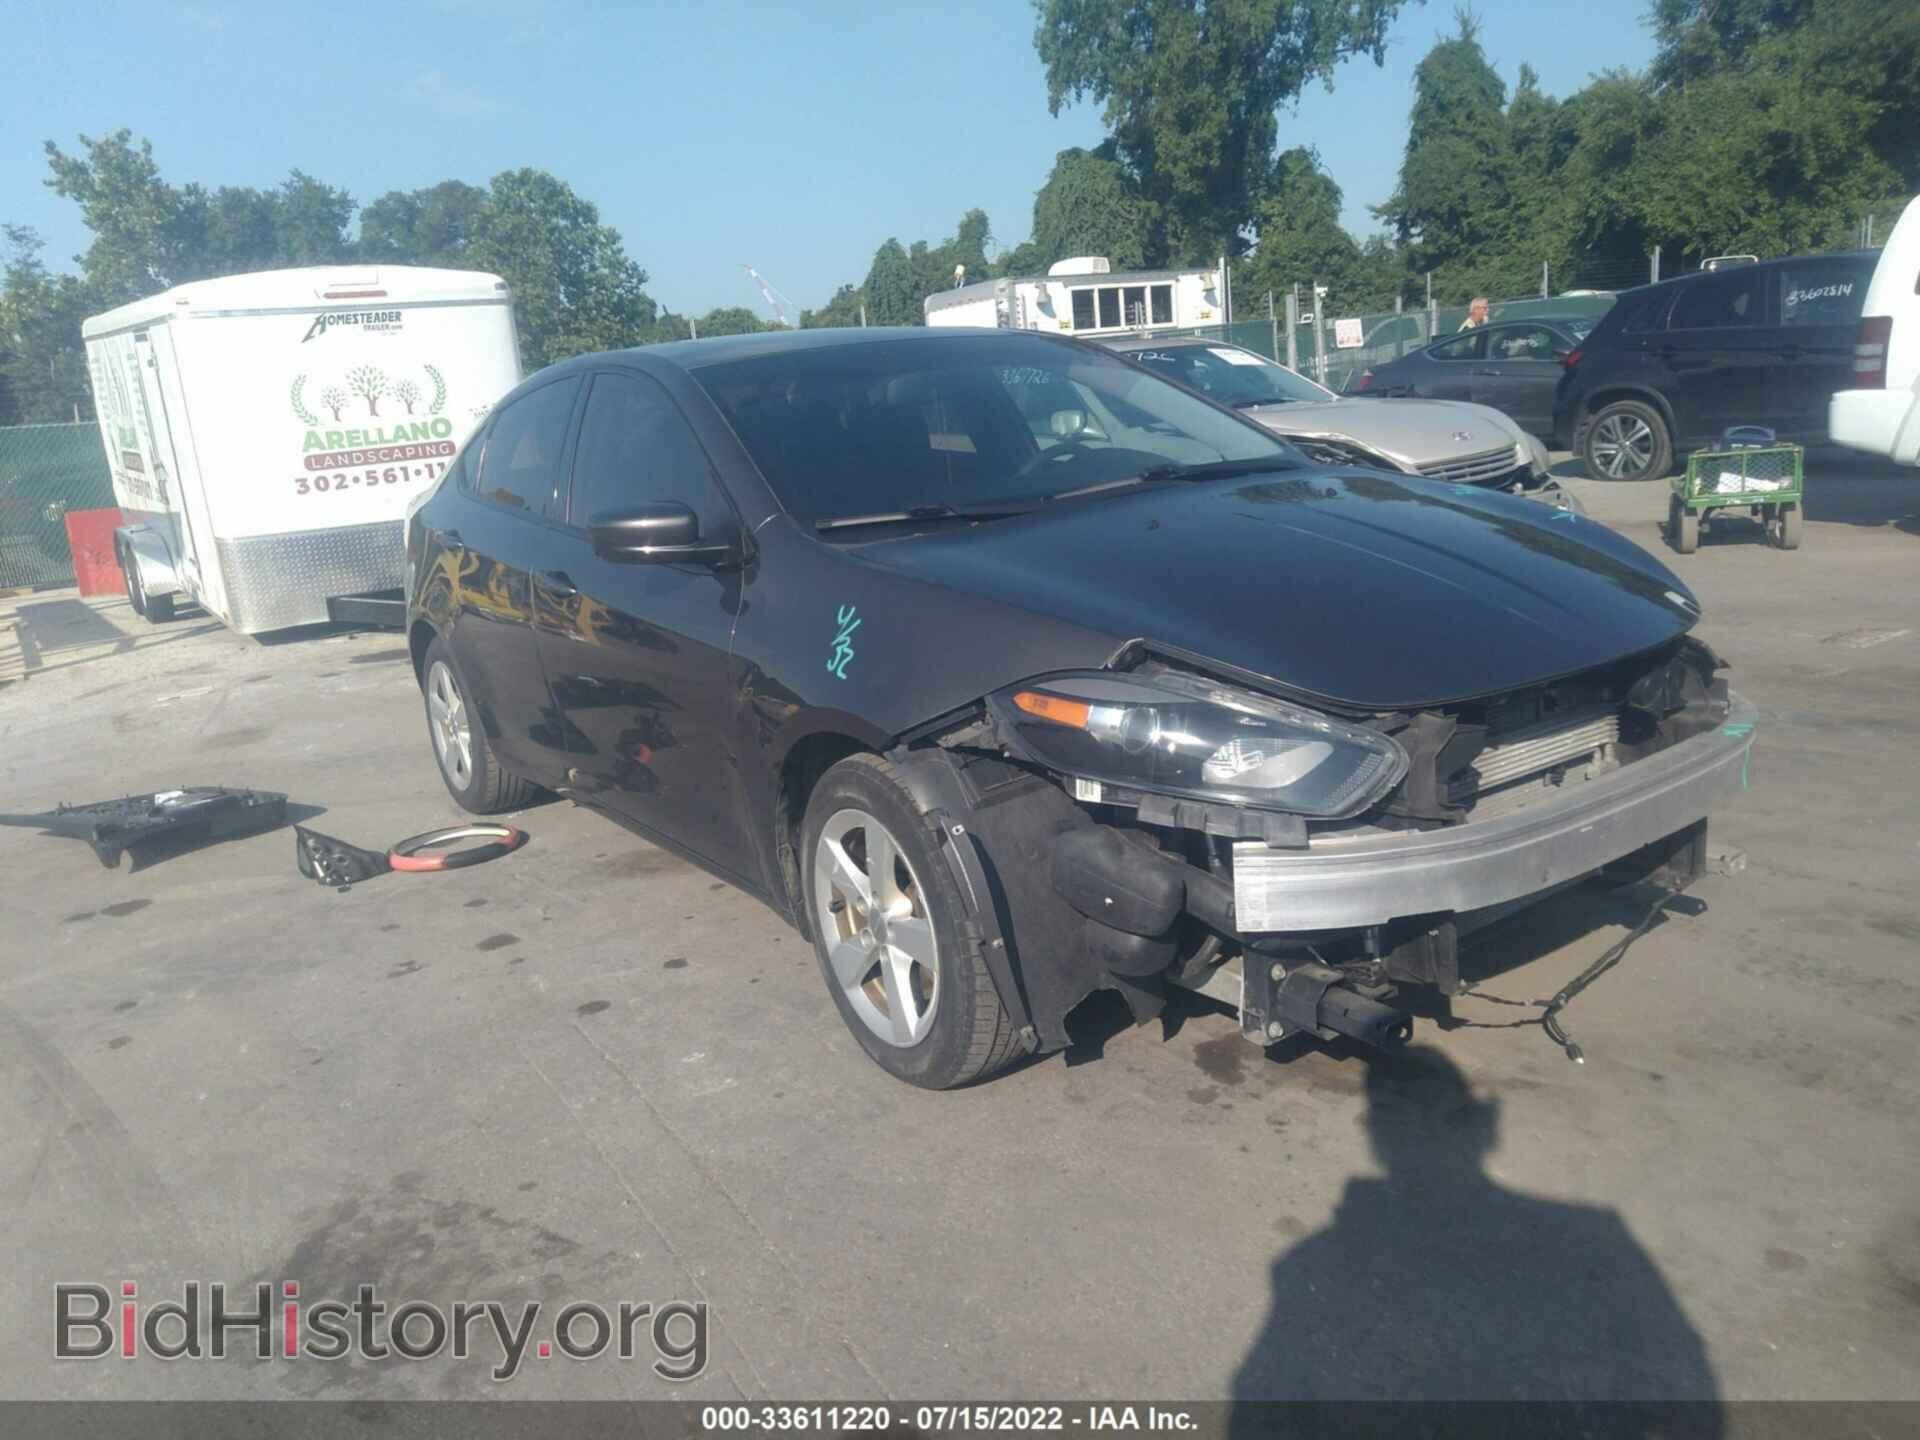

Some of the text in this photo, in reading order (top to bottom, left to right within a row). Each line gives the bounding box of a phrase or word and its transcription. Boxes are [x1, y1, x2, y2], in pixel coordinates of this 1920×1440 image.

[301, 311, 402, 343] HOMESTEADER
[303, 417, 453, 452] ARELLANO
[310, 442, 451, 470] LANDSCAPING
